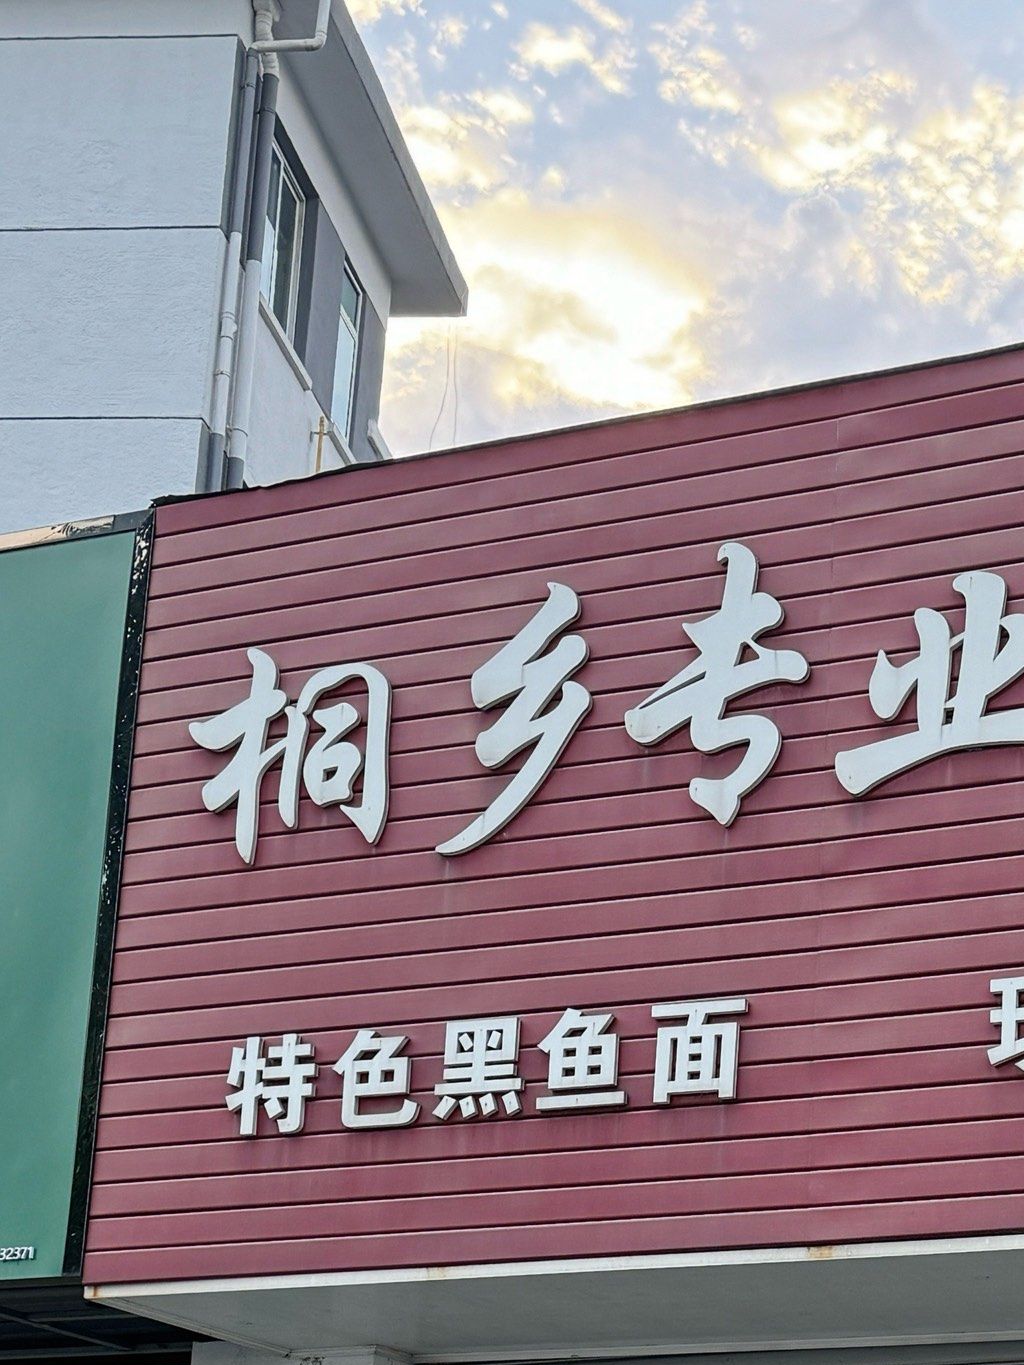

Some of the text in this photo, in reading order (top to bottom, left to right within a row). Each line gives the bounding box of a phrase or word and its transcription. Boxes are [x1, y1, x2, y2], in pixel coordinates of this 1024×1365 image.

[225, 998, 749, 1137] 特色黑鱼面
